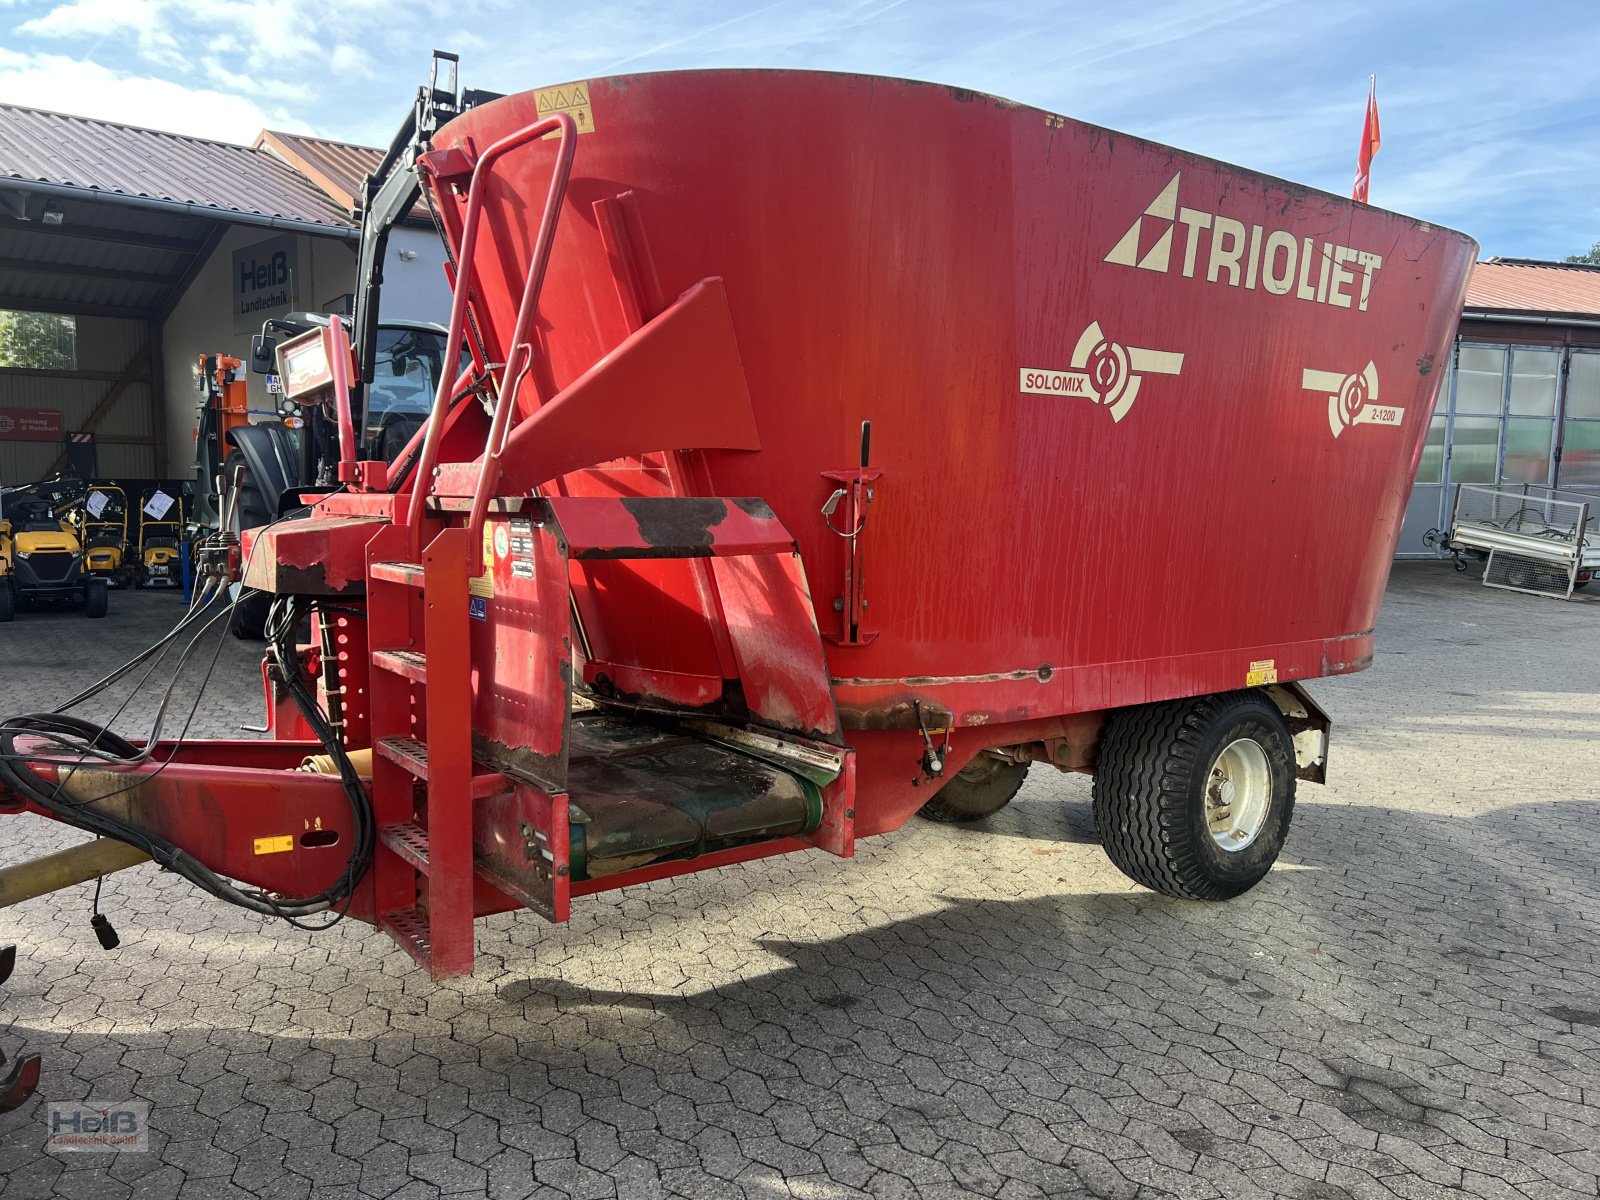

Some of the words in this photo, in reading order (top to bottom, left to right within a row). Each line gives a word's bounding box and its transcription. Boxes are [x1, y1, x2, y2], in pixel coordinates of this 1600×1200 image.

[1179, 206, 1382, 312] TRIOLIET
[241, 251, 288, 294] Heiß
[241, 291, 288, 314] Landtechnik
[1025, 373, 1085, 393] SOLOMIX
[1371, 408, 1396, 422] 2-1200
